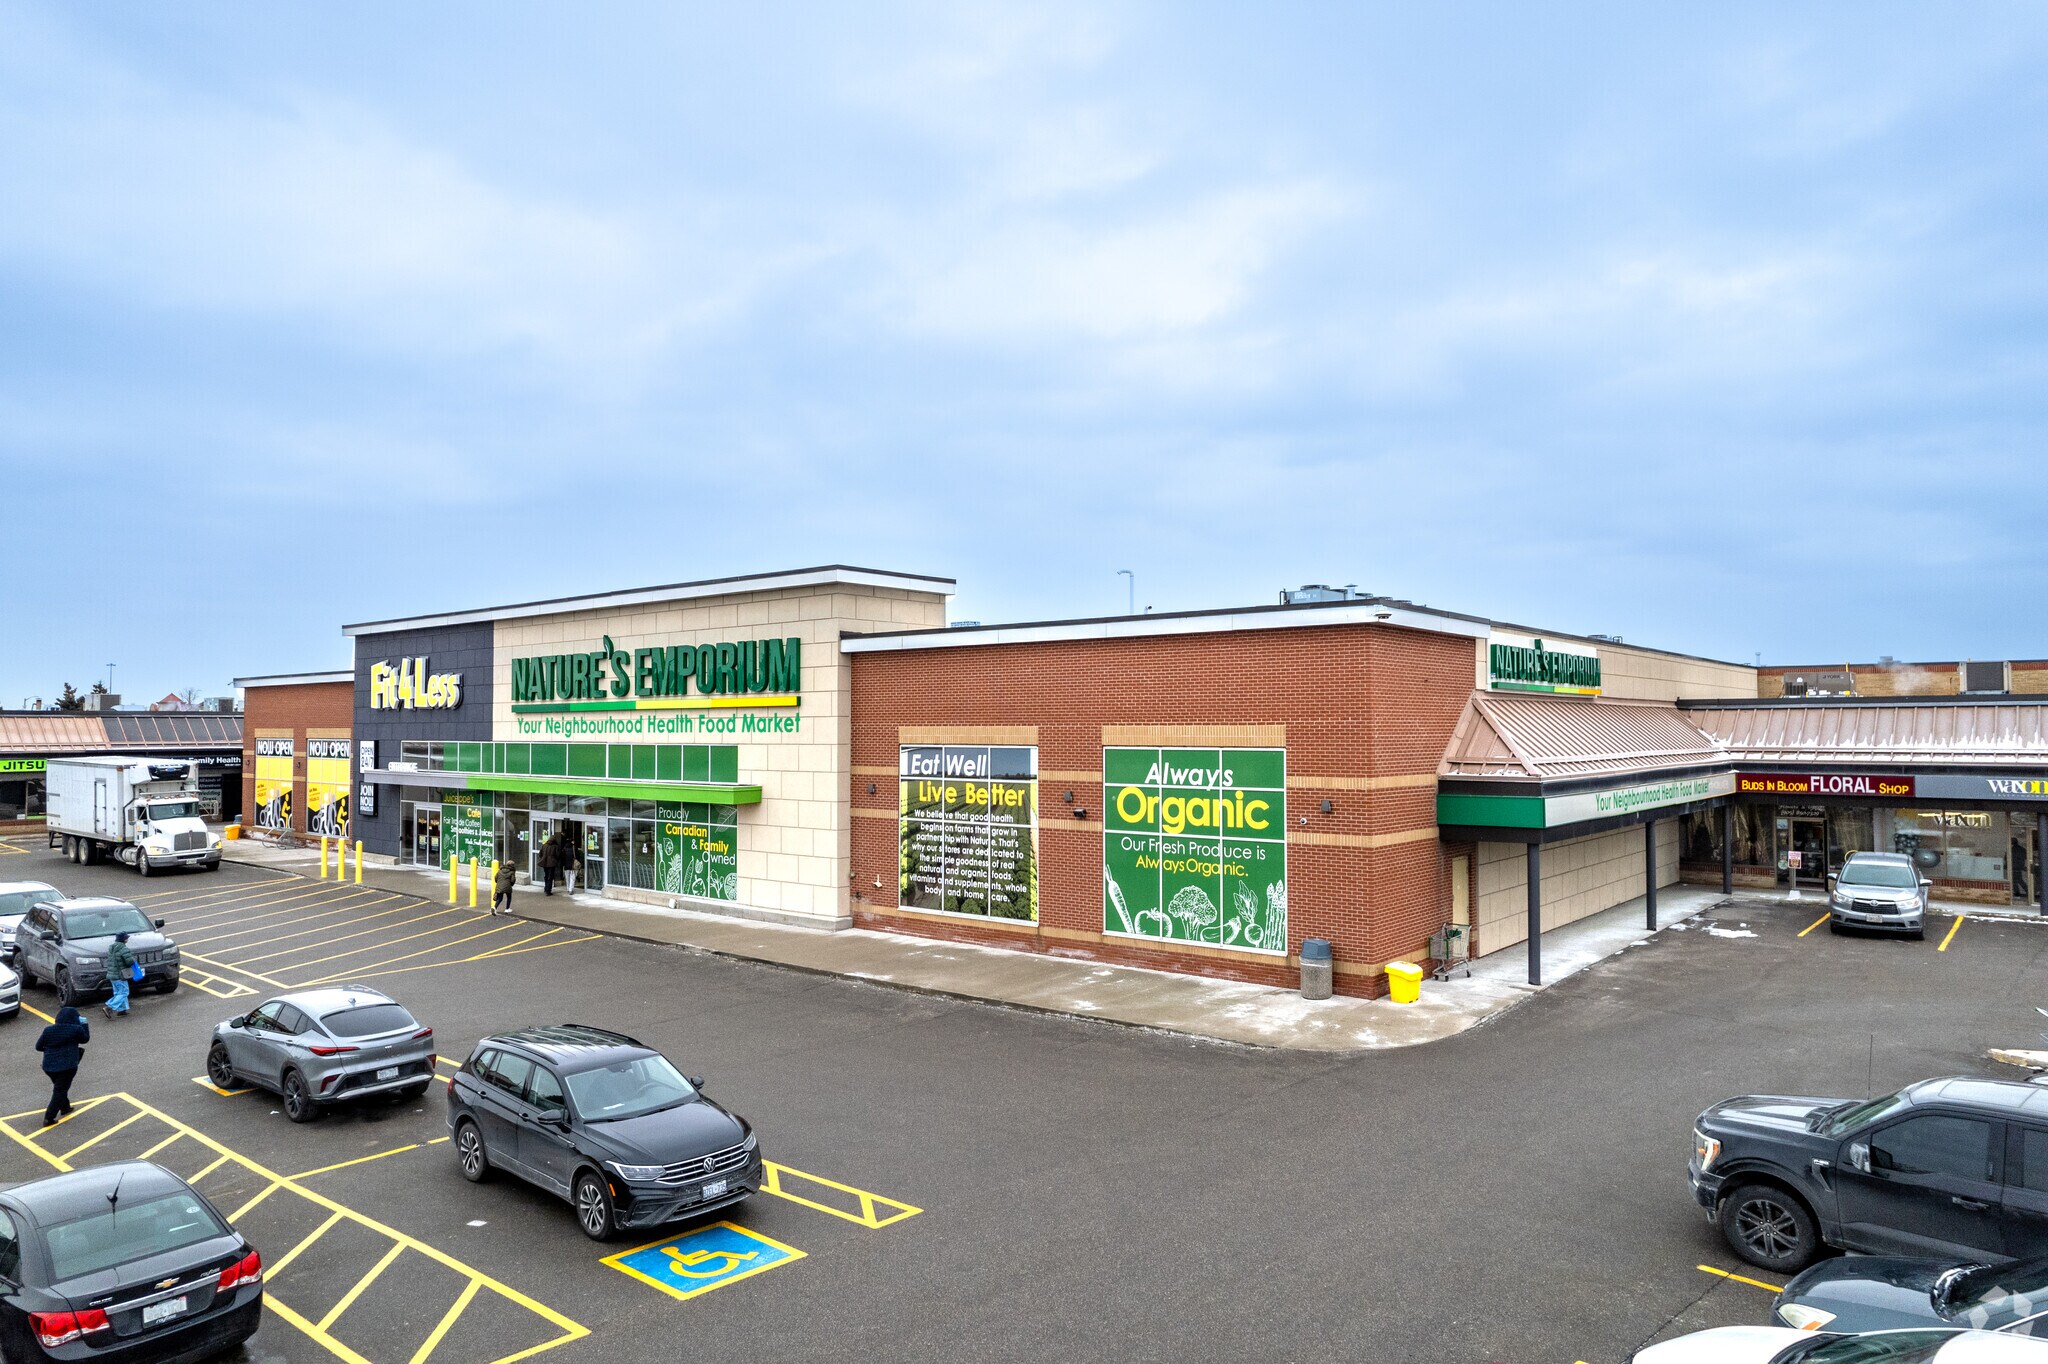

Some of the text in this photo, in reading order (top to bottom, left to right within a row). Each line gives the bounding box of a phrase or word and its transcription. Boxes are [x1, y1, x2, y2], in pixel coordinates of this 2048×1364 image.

[512, 635, 801, 700] NATURE'S EMPORIUM
[1491, 639, 1600, 687] NATURE'S EMPORIUM
[517, 712, 800, 738] Your Neighbourhood Health Food Market
[257, 741, 292, 755] NOW OPEN
[309, 742, 349, 756] NOW OPEN
[361, 747, 374, 755] OPEN
[3, 761, 45, 770] JITSU
[911, 754, 987, 777] Eat Well
[1144, 762, 1234, 791] Always
[360, 785, 374, 796] JOIN
[1742, 779, 1764, 791] BUDS
[1766, 780, 1775, 791] IN
[1777, 780, 1808, 792] BLOOM
[1810, 776, 1875, 793] FLORAL
[1879, 783, 1909, 794] SHOP
[360, 796, 374, 807] NOW
[919, 781, 1025, 806] Live Better
[1595, 793, 1611, 811] Your
[1613, 787, 1660, 811] Neighbourhood
[1662, 783, 1679, 800] Health
[1680, 782, 1692, 797] Food
[659, 807, 690, 822] Proudly
[914, 809, 1013, 823] We believe that good health
[1116, 786, 1269, 835] Organic
[465, 819, 480, 828] Coffee
[665, 823, 707, 837] Canadian
[920, 822, 943, 832] begins
[954, 824, 974, 833] farms
[975, 825, 989, 834] that
[991, 828, 1010, 837] grow
[1011, 828, 1017, 836] in
[691, 839, 729, 855] & Family
[916, 834, 1018, 848] partnership with Nature. That's
[1121, 836, 1266, 860] Our Fresh Produce is
[702, 851, 736, 866] Owned
[912, 843, 925, 852] why
[939, 846, 960, 854] stores
[975, 847, 1015, 859] dedicated
[1016, 851, 1024, 859] to
[920, 854, 1015, 869] the simple goodness of real
[1136, 855, 1248, 877] Always Organic.
[920, 864, 1013, 881] natural and organic foods,
[909, 874, 1027, 893] vitamins and supplements, whole
[925, 885, 1010, 902] body and home care.
